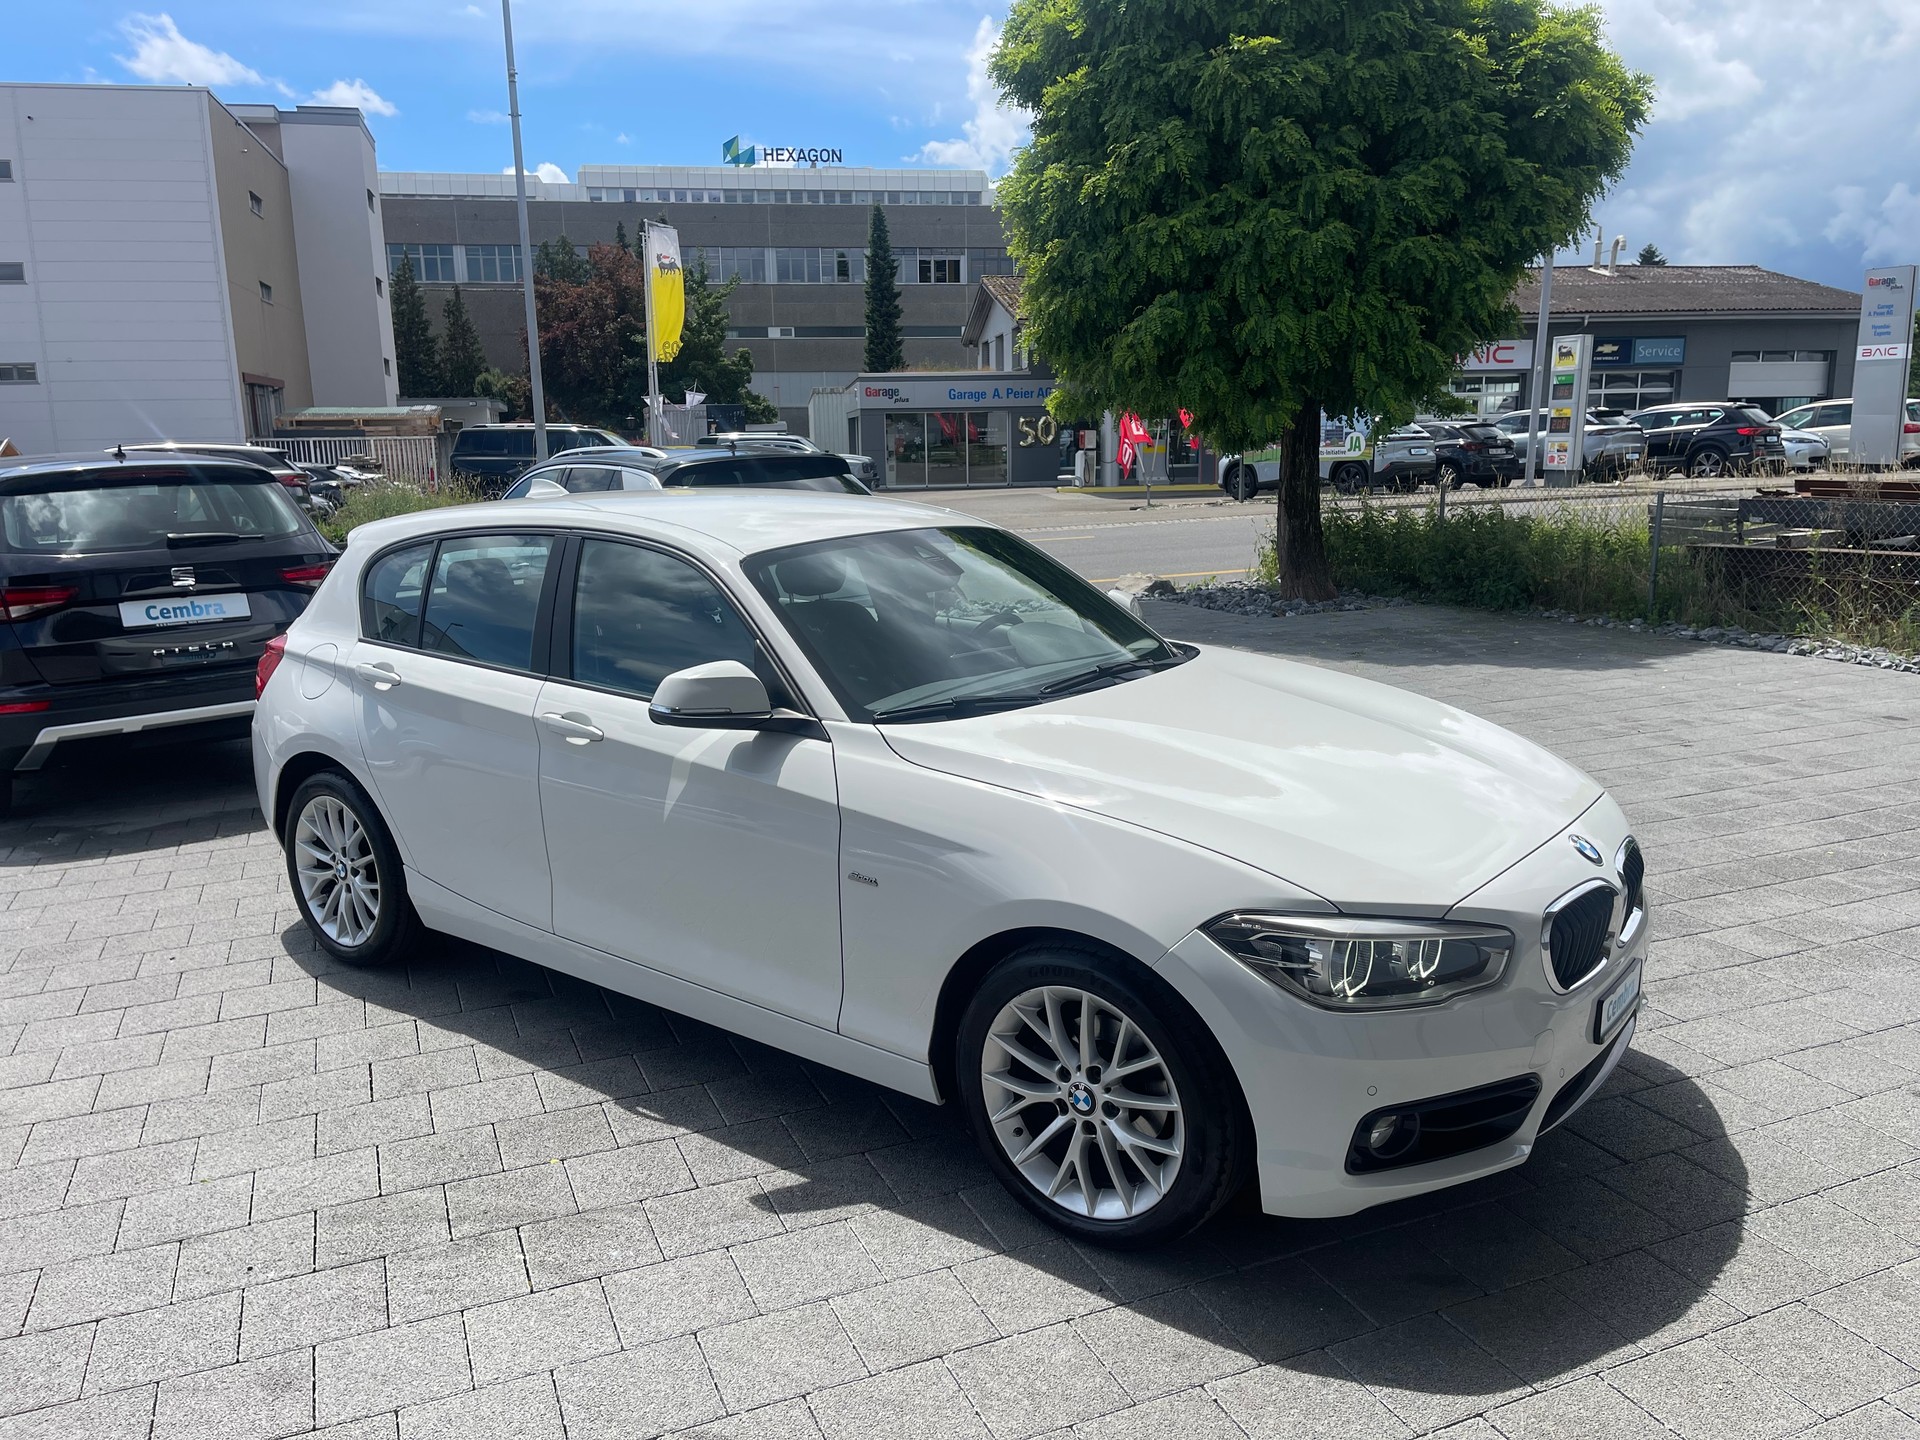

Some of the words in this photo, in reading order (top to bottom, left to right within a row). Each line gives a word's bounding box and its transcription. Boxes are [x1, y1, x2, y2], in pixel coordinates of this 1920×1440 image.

[763, 147, 842, 162] HEXAGON
[1869, 277, 1896, 287] Garage
[1638, 345, 1681, 357] Service
[1862, 347, 1898, 357] BAIC
[865, 386, 900, 399] Garage
[948, 388, 987, 402] Garage
[992, 388, 1003, 399] A.
[1006, 387, 1034, 399] Peier
[894, 396, 910, 404] plus
[1017, 416, 1057, 446] 50
[1347, 436, 1361, 452] JA
[145, 600, 226, 620] Cembra
